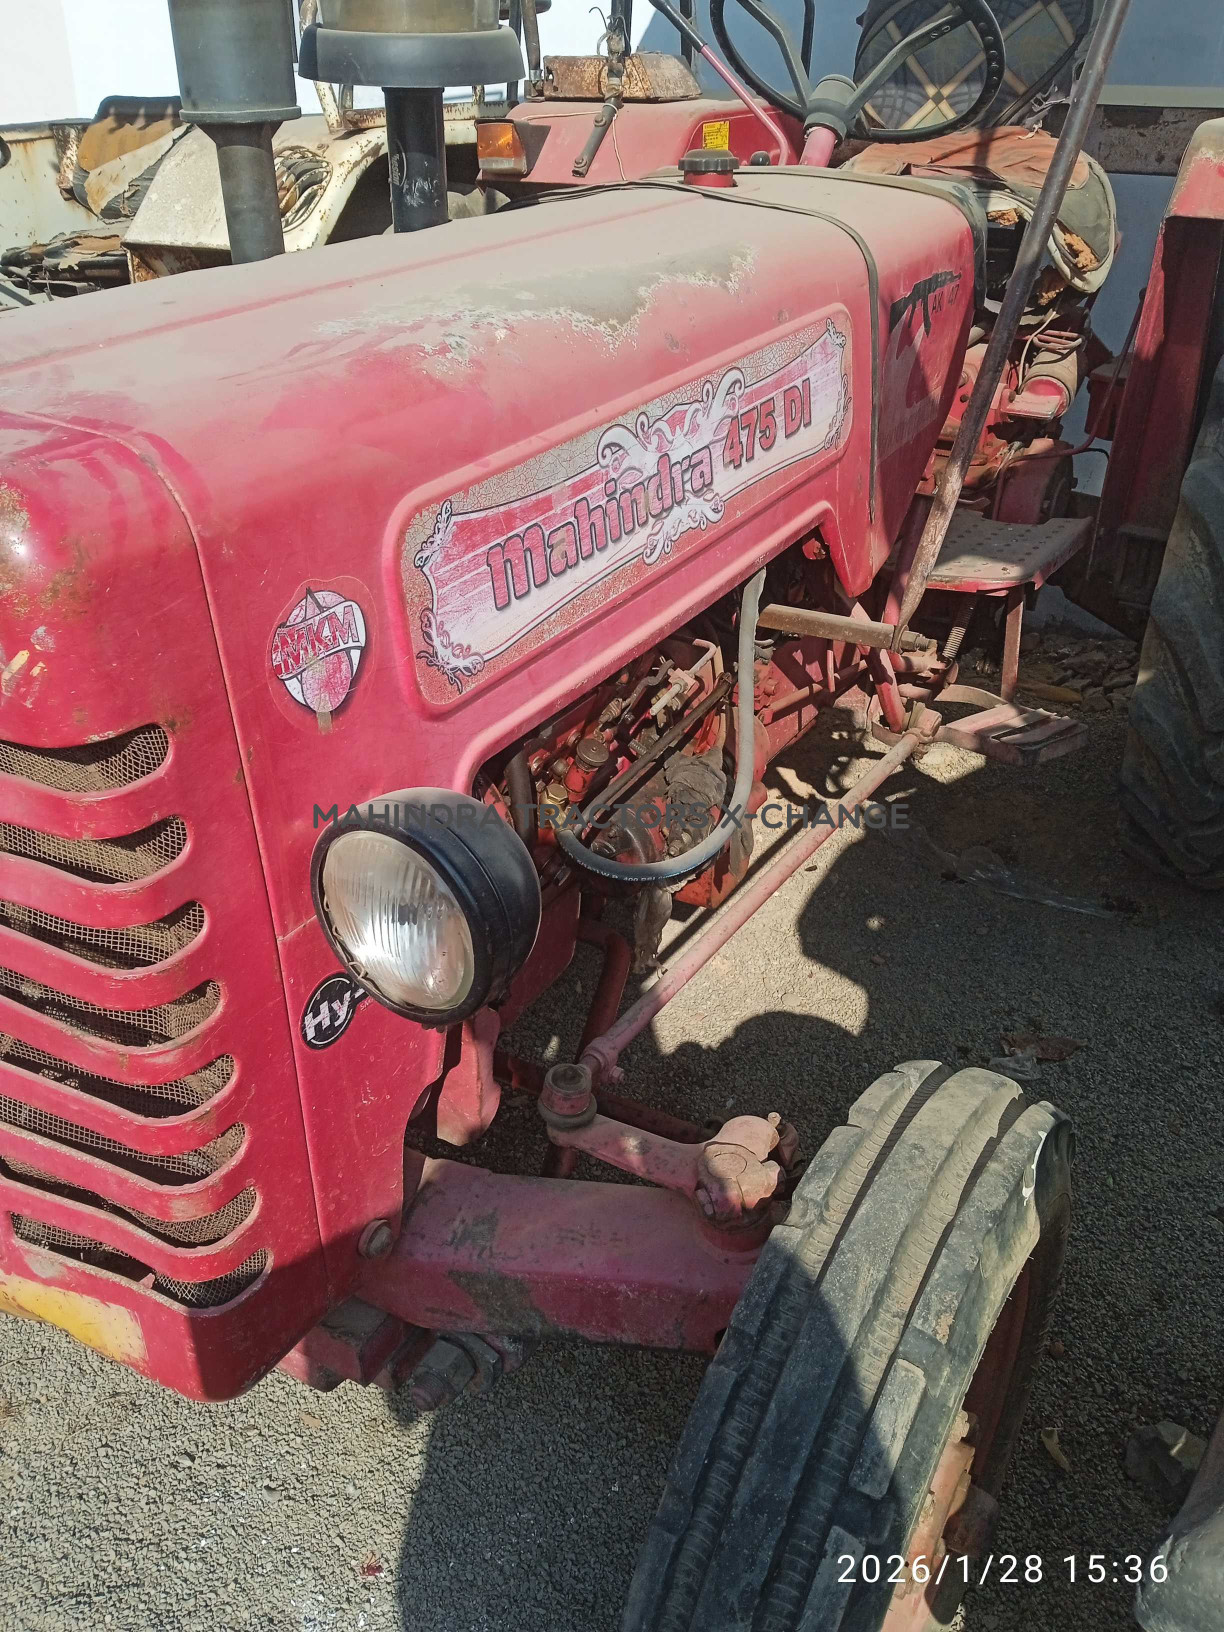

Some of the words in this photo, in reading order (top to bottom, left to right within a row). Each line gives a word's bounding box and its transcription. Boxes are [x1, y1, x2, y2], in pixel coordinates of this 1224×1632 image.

[931, 291, 943, 315] AK
[486, 444, 713, 610] Mahindra
[722, 398, 777, 471] 475
[784, 378, 812, 440] DI
